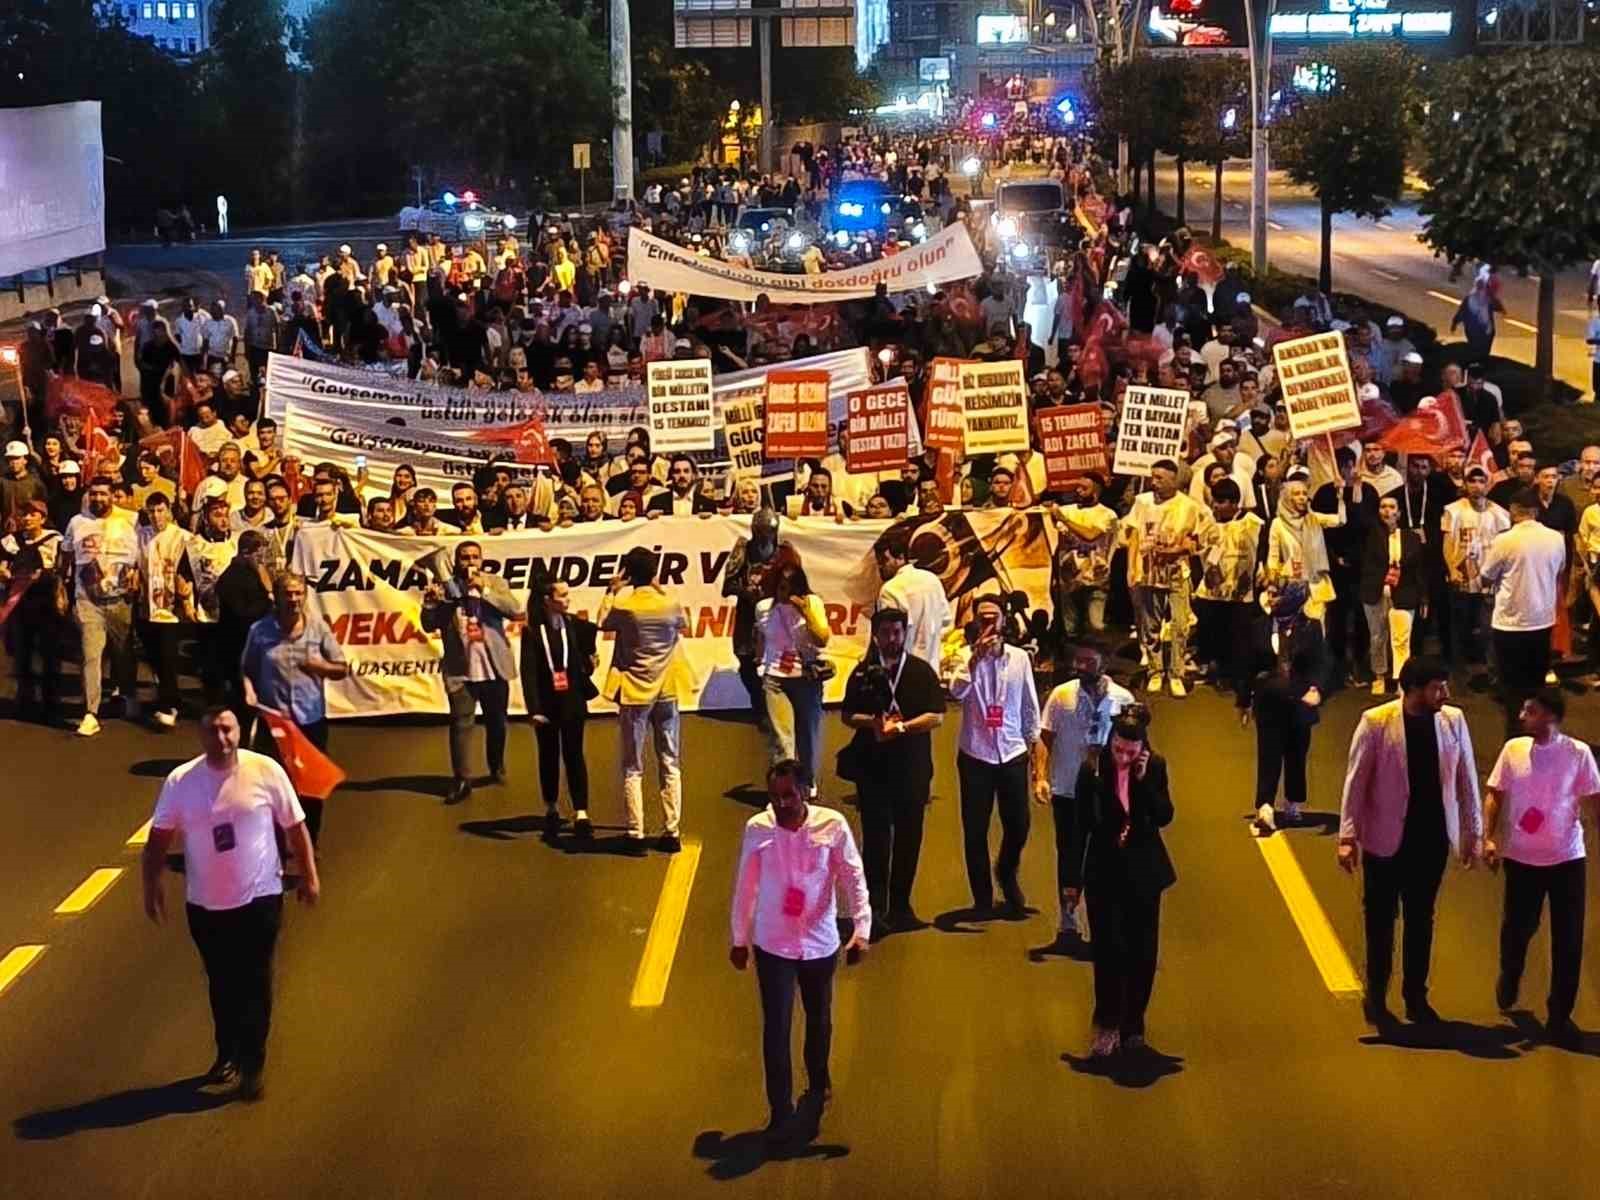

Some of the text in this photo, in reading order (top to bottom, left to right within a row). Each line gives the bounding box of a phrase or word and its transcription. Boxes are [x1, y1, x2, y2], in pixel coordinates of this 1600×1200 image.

[811, 266, 902, 290] dosdoğru
[907, 237, 954, 273] olun"
[652, 400, 710, 414] DESTANI
[849, 391, 907, 413] O GECE
[1129, 391, 1186, 410] TEK MİLLET
[850, 414, 867, 433] BİR
[869, 411, 907, 430] MİLLET
[1041, 417, 1053, 433] 15
[1126, 407, 1182, 425] TEK BAYRAK
[1124, 423, 1180, 441] TEK VATAN
[1044, 437, 1064, 452] ADI
[1121, 438, 1177, 457] TEK DEVLET
[316, 559, 428, 592] ZAMA
[700, 551, 732, 584] V
[323, 611, 429, 645] MEKA
